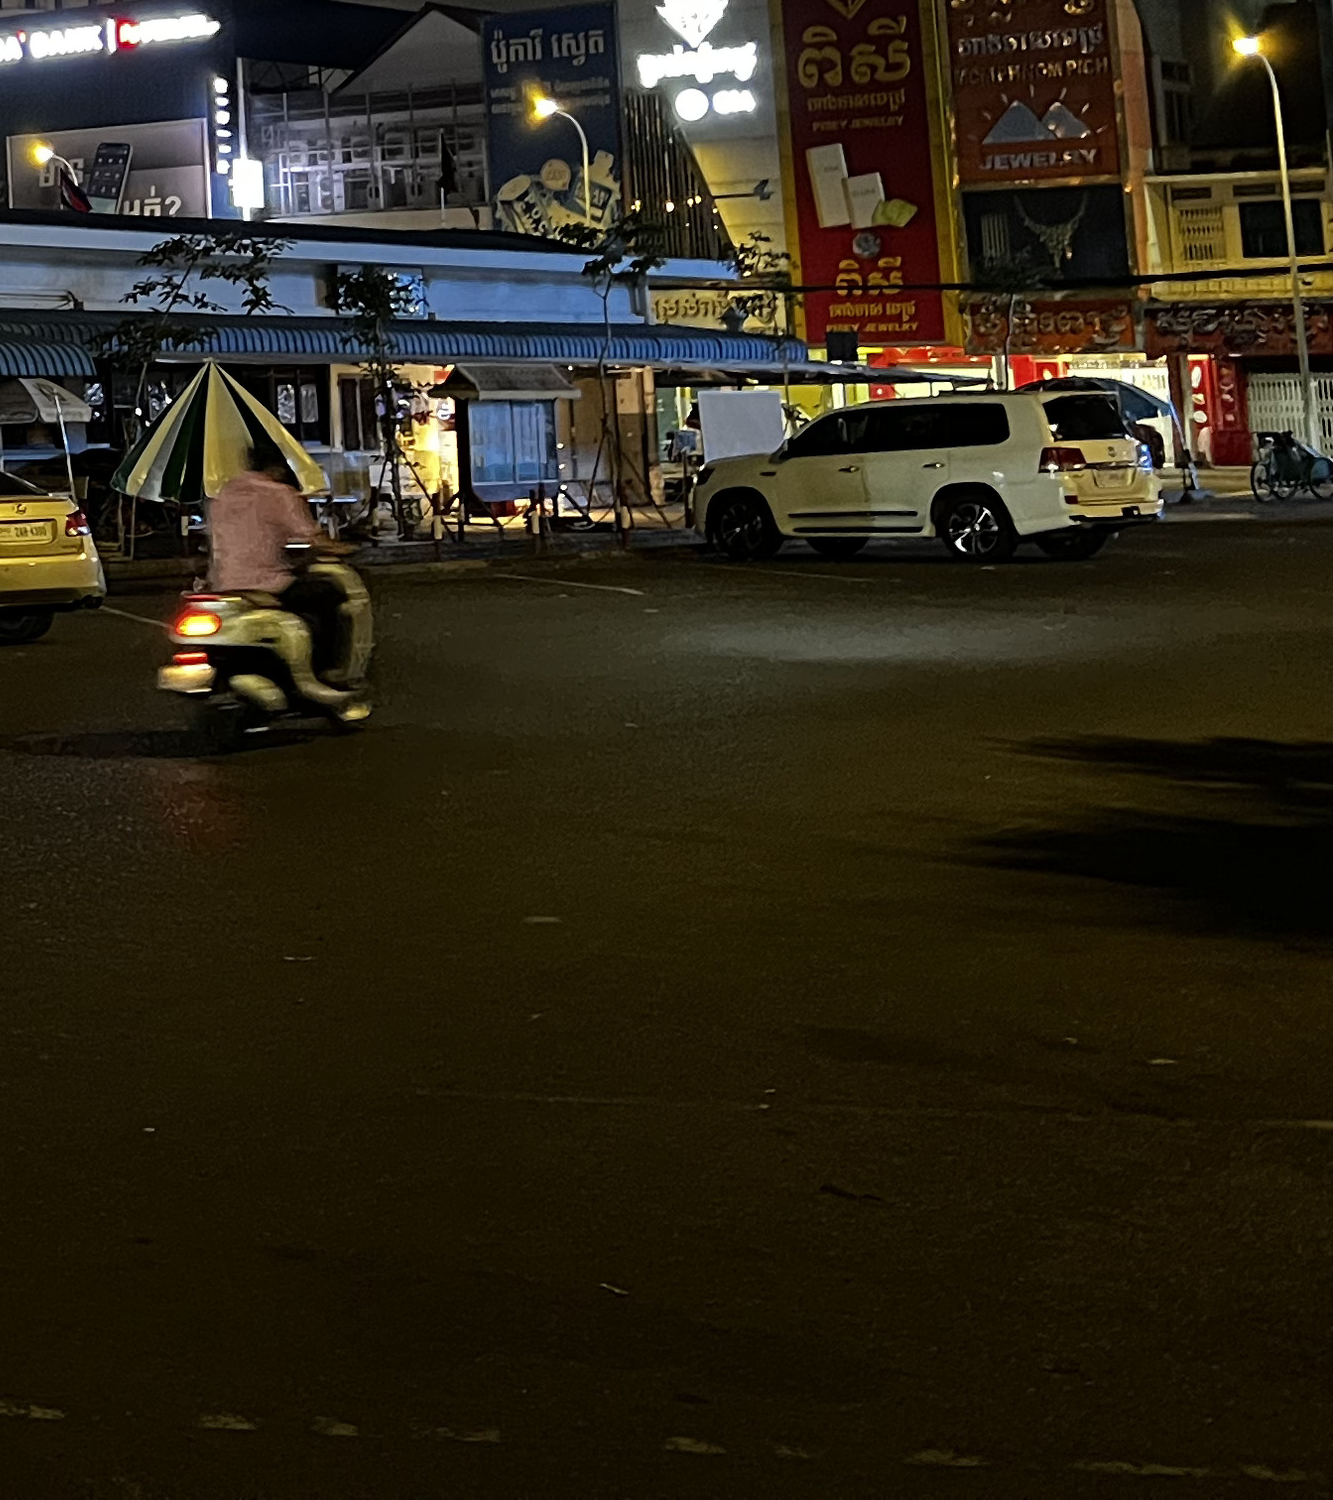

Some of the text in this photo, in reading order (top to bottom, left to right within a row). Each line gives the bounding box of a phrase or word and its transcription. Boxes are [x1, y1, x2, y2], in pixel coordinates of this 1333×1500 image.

[29, 24, 104, 60] BANK
[979, 148, 1098, 171] JEWELRY
[863, 321, 919, 332] JEWELRY
